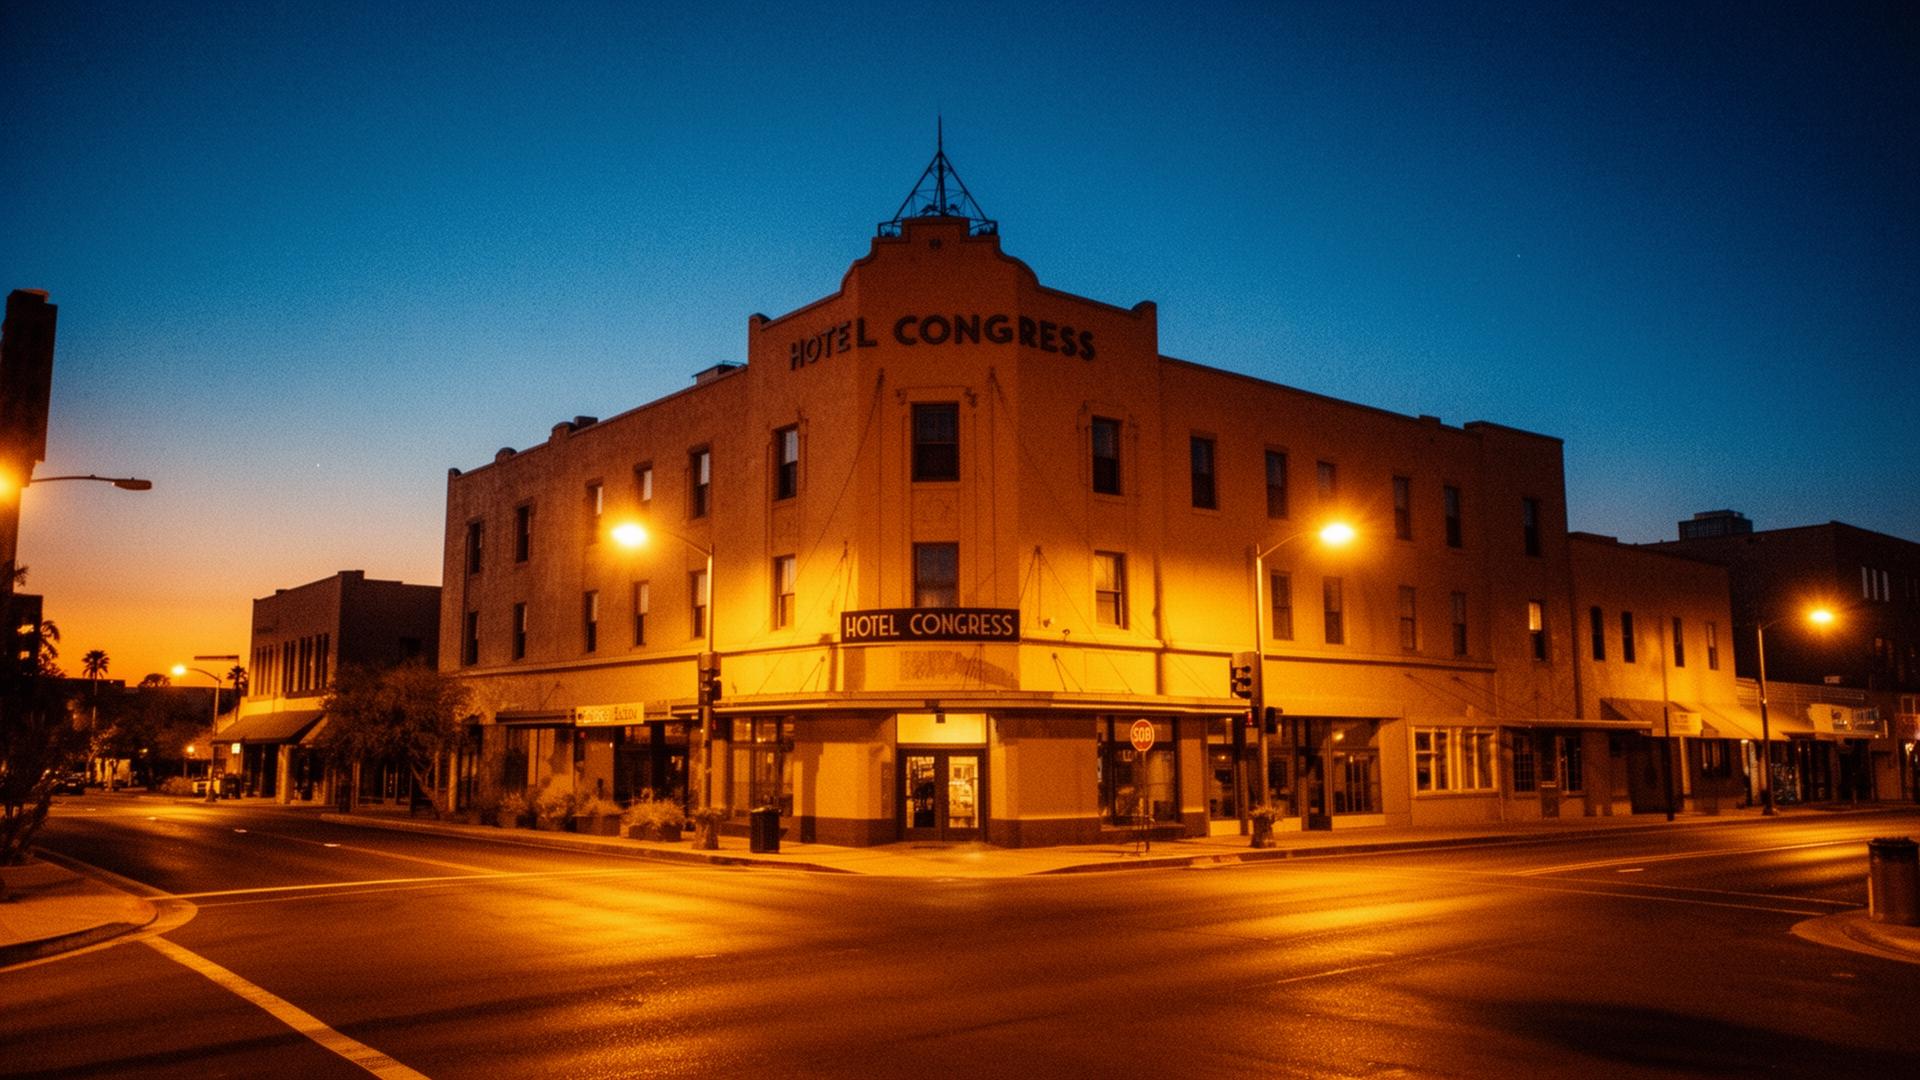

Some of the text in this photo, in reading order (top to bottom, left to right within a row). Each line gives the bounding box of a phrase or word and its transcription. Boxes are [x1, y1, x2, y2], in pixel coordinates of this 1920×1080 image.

[790, 314, 1095, 370] HOTEL CONGRESS
[845, 613, 1014, 638] HOTEL CONGRESS
